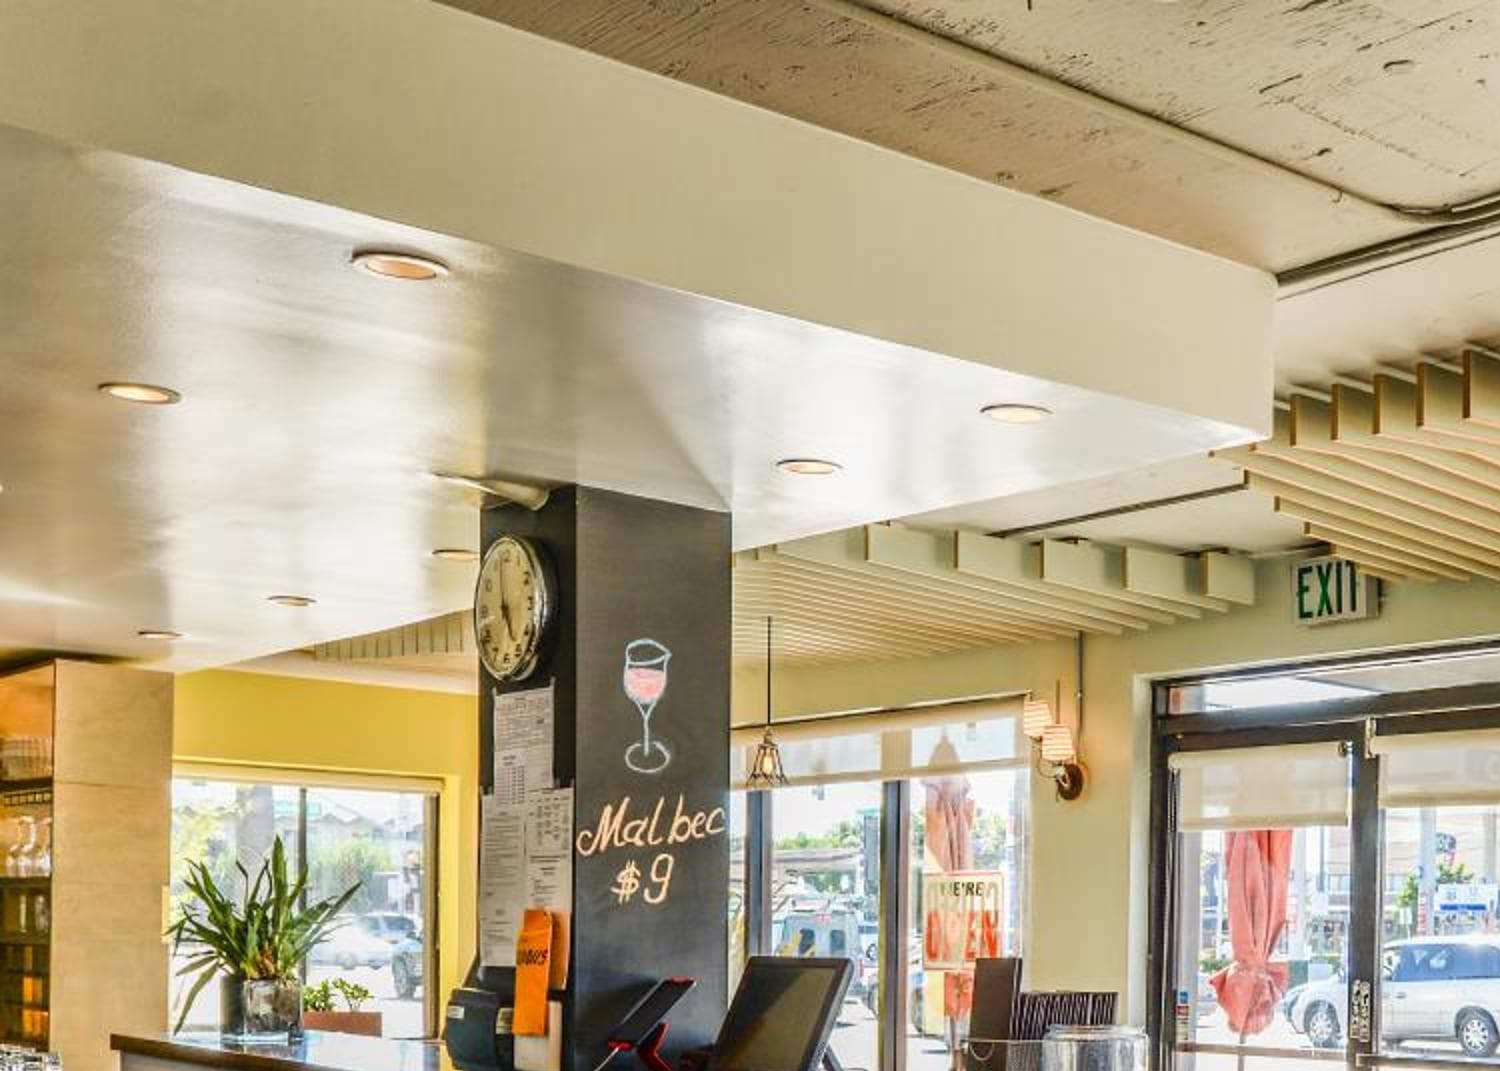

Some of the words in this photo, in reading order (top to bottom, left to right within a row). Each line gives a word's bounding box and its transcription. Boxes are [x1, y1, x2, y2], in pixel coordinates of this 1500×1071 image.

[1297, 560, 1357, 619] EXIT
[576, 793, 726, 857] Malbec
[610, 852, 674, 905] $9
